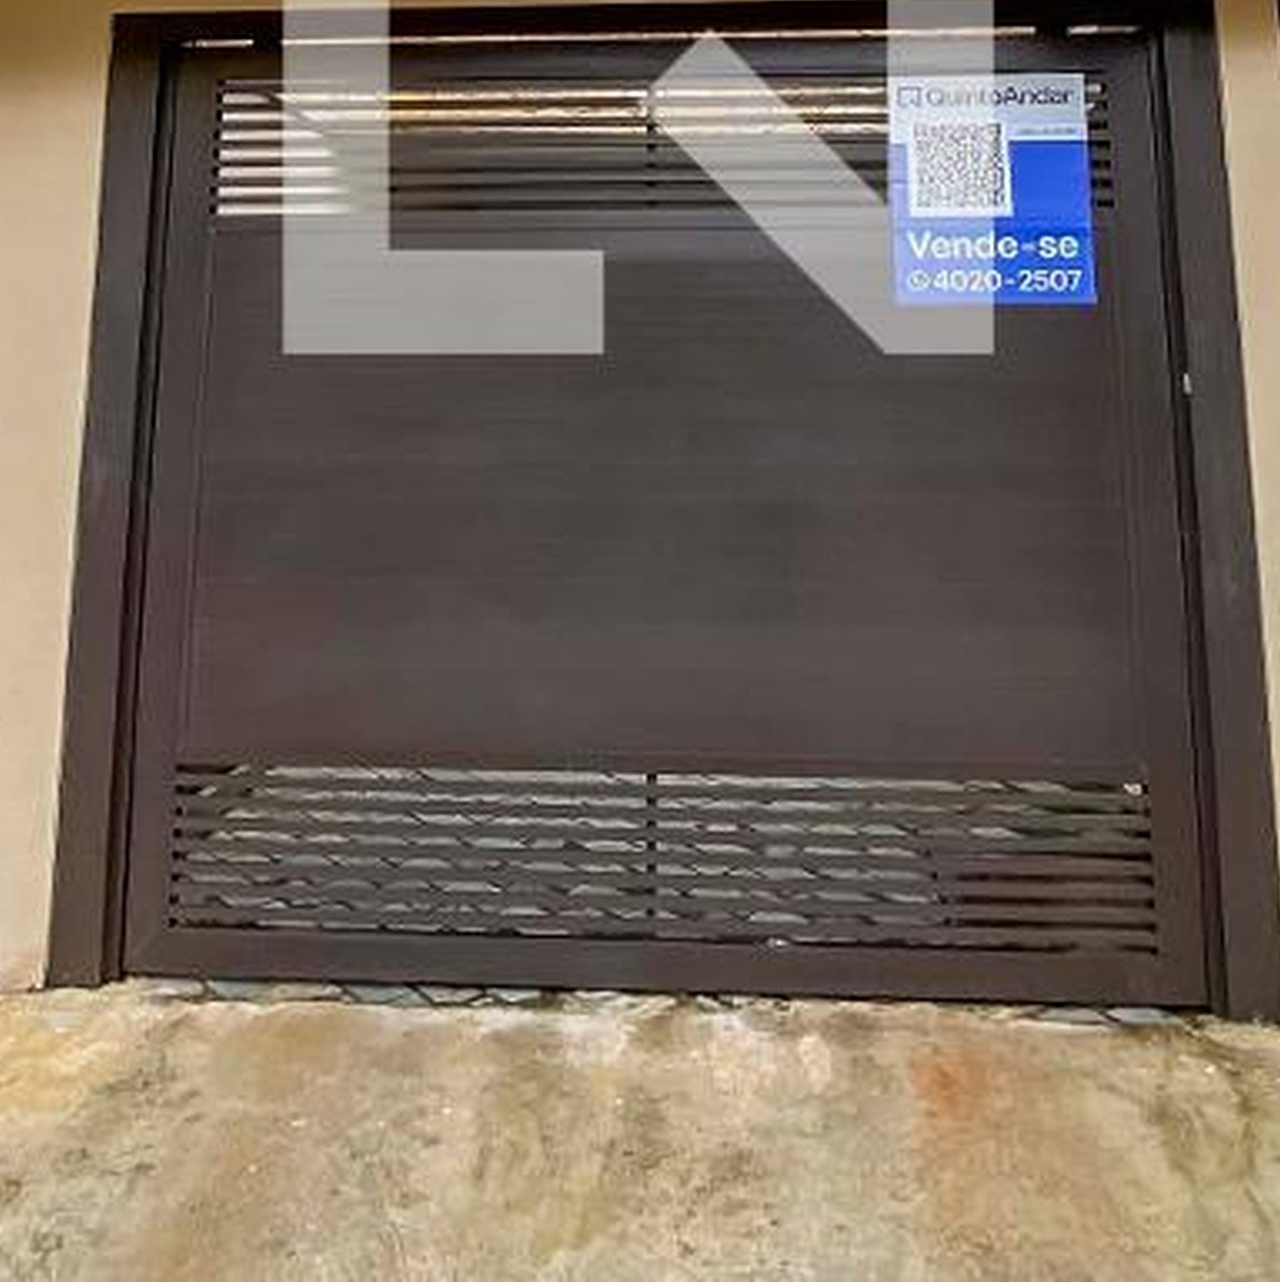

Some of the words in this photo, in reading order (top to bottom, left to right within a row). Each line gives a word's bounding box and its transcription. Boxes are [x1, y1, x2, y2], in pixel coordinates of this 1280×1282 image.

[926, 85, 1073, 107] QuintoAndar
[906, 229, 1079, 259] Vende-se
[933, 269, 1082, 292] 4020-2507
